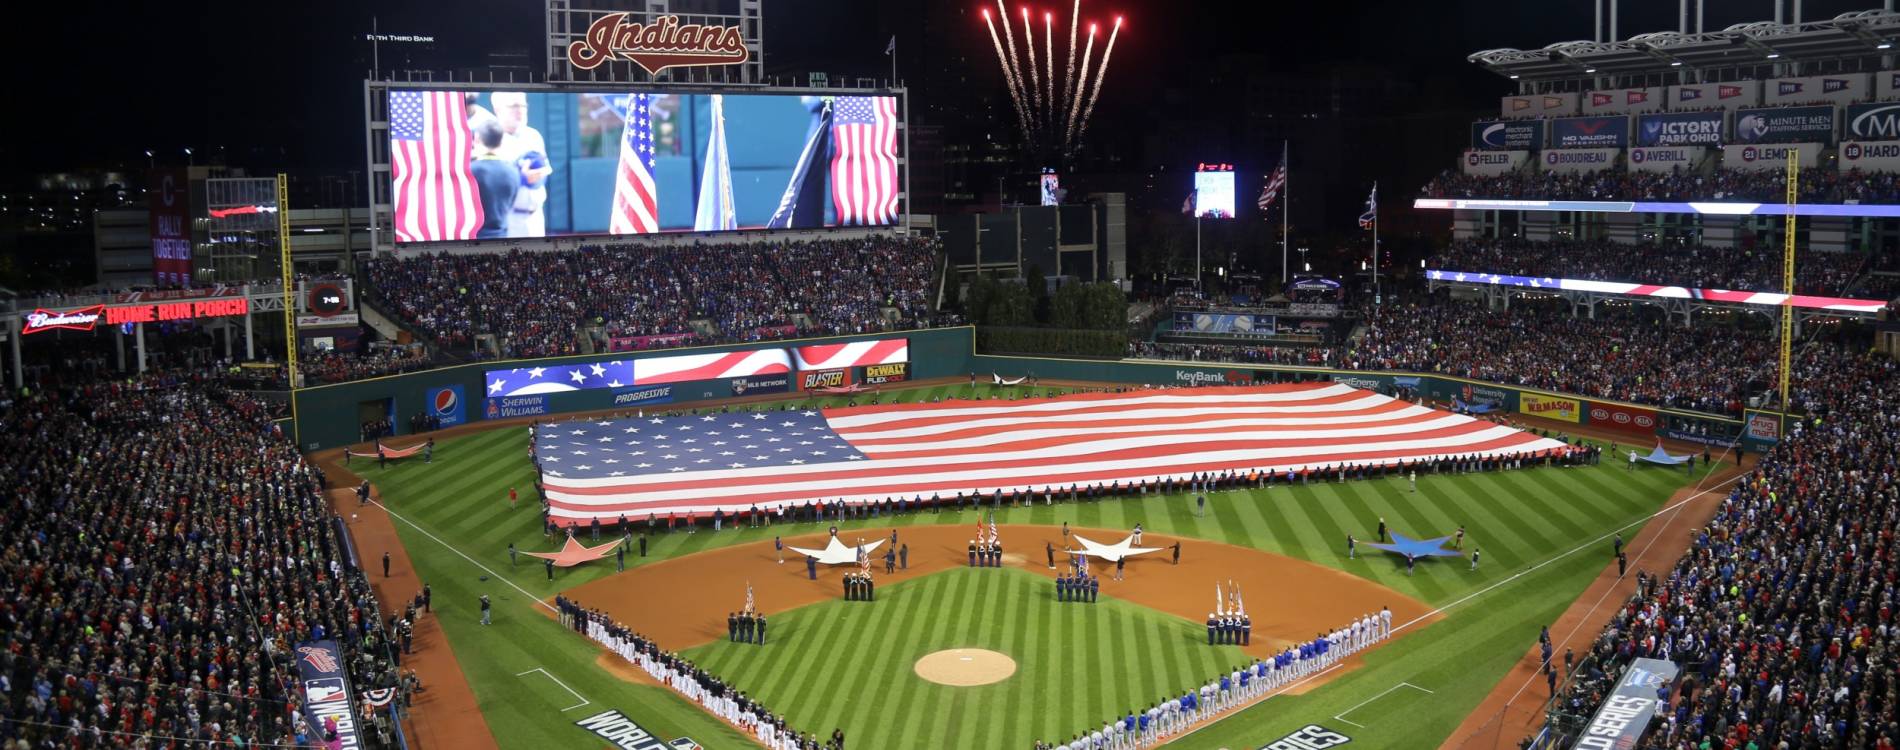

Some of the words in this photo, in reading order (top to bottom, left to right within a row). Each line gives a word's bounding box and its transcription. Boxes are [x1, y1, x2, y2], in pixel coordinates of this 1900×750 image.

[568, 12, 748, 75] Indians
[1770, 116, 1807, 126] MINUTE
[1809, 115, 1831, 123] MEN
[1867, 113, 1900, 137] M
[1660, 134, 1688, 143] PARK
[1689, 133, 1720, 143] OHIO
[1560, 152, 1607, 163] BOUDREAU
[1646, 149, 1687, 161] AVERILL
[1745, 149, 1755, 159] 21
[1848, 147, 1859, 156] 18
[1480, 154, 1509, 165] FELLER
[157, 215, 182, 236] RALLY
[152, 238, 192, 260] TOGETHER
[106, 305, 154, 324] HOME
[158, 302, 192, 320] RUN
[194, 298, 247, 318] PORCH
[28, 313, 98, 327] Budweiser
[760, 379, 787, 387] NETWORK
[805, 372, 843, 388] BLASTER
[1176, 370, 1225, 386] KeyBank
[615, 388, 670, 404] PROGRESSIVE
[1473, 386, 1506, 399] University
[502, 397, 542, 407] SHERWIN
[1638, 417, 1650, 425] KIA
[1751, 417, 1773, 430] drug
[1680, 434, 1707, 444] University
[1752, 429, 1776, 437] mart
[1589, 695, 1650, 737] SERIES
